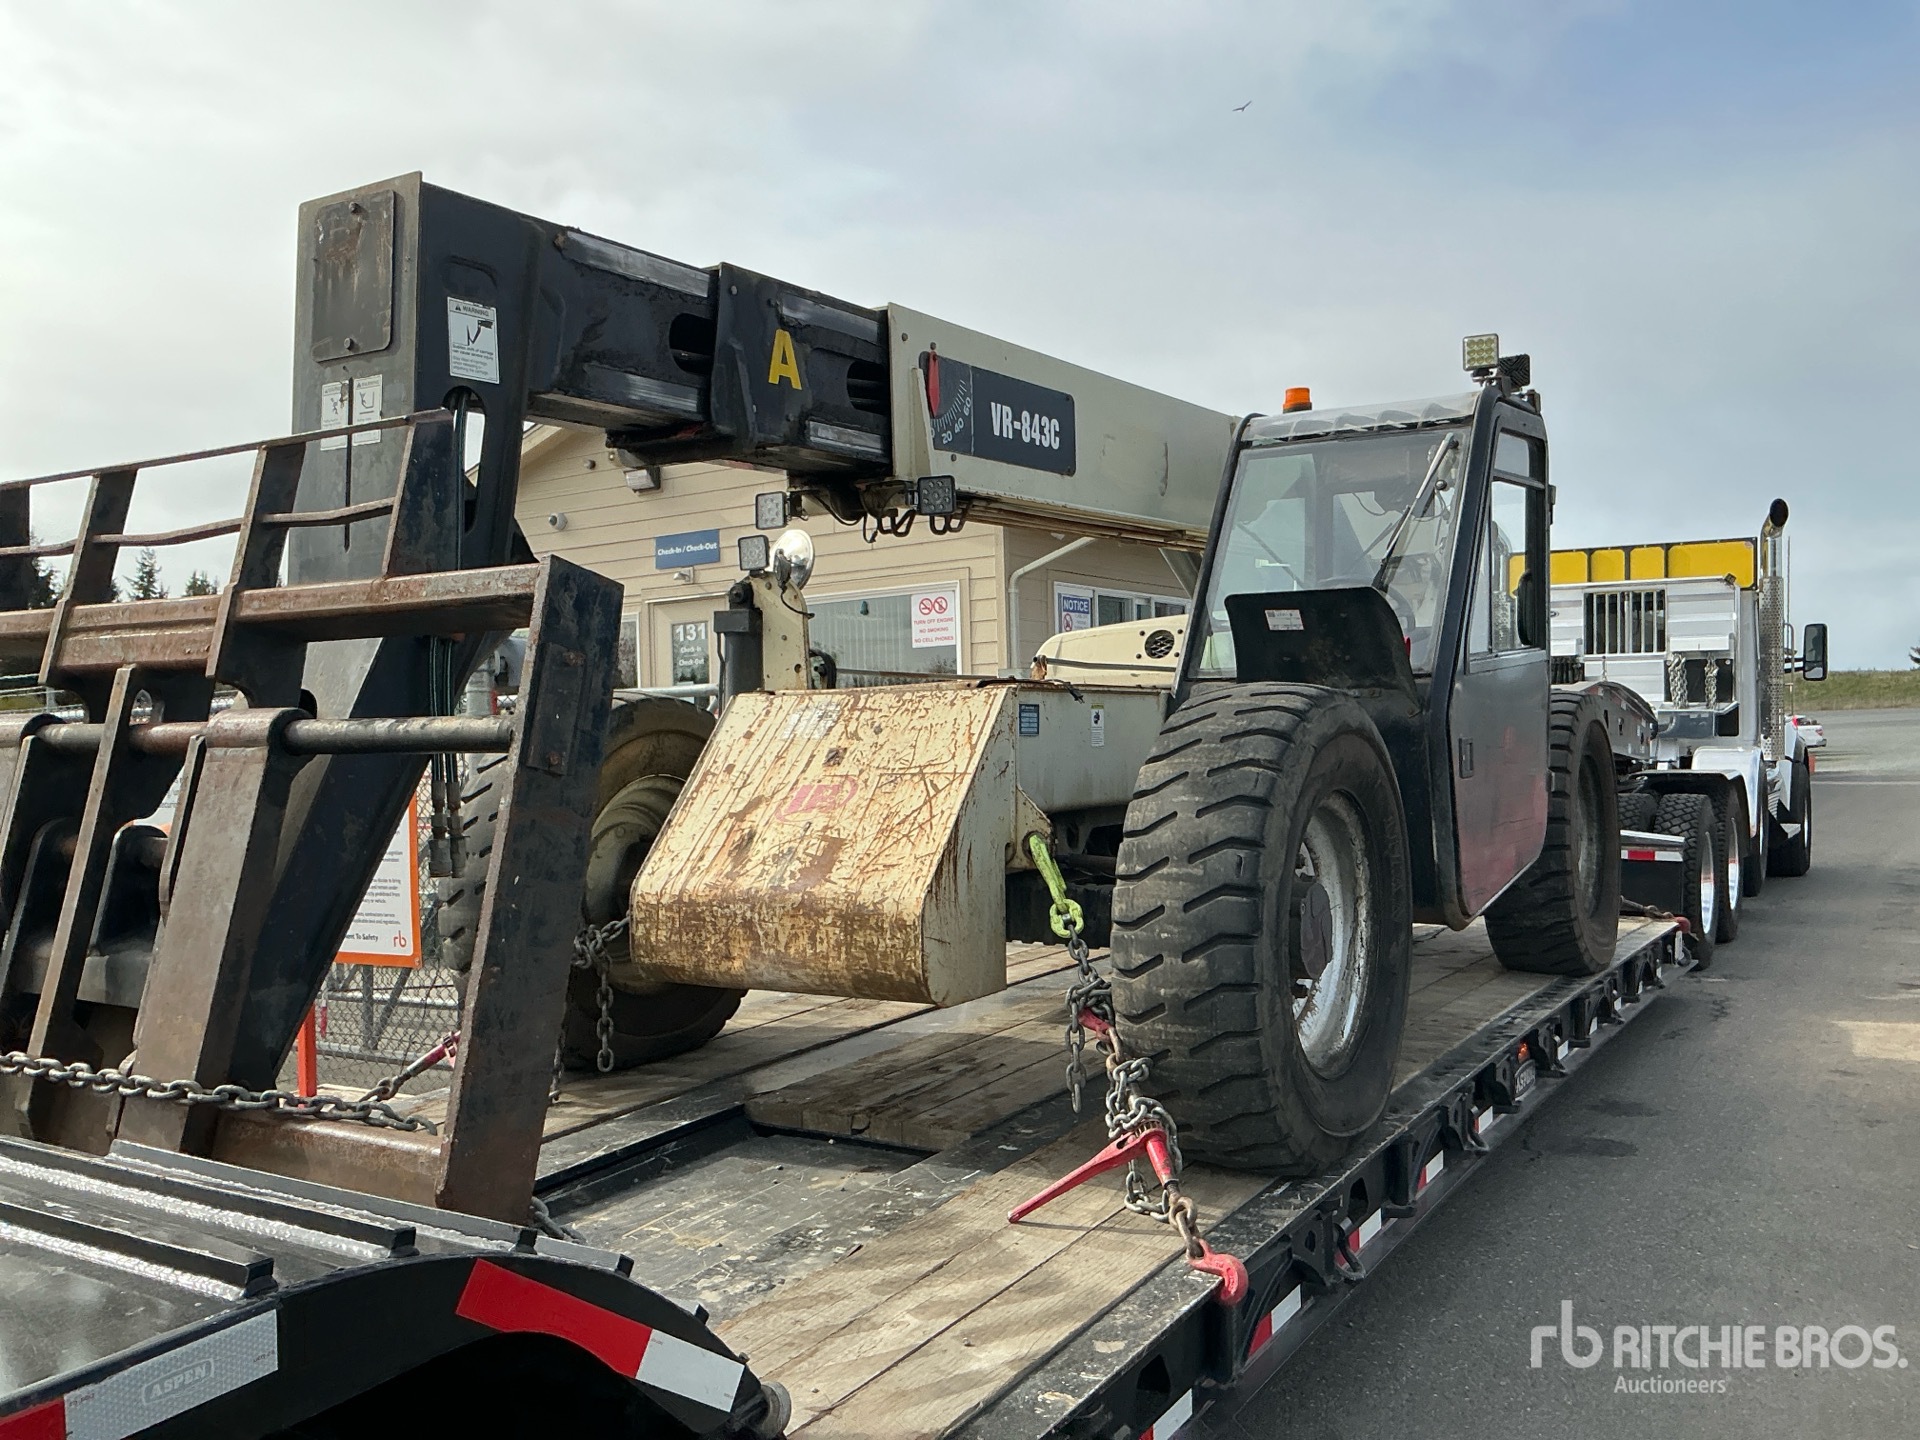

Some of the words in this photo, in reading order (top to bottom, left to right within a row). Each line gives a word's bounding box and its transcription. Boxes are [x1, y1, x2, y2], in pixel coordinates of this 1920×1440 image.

[768, 328, 803, 390] A
[941, 430, 953, 445] 20
[954, 417, 965, 434] 40
[963, 396, 971, 416] 60
[990, 401, 1060, 450] VR-843C
[657, 546, 682, 556] Check-In
[686, 542, 718, 552] Check-Out
[1063, 599, 1089, 612] NOTICE
[676, 622, 706, 642] 131
[362, 933, 379, 942] Safety
[393, 930, 407, 948] rb
[150, 1364, 208, 1396] ASPEN
